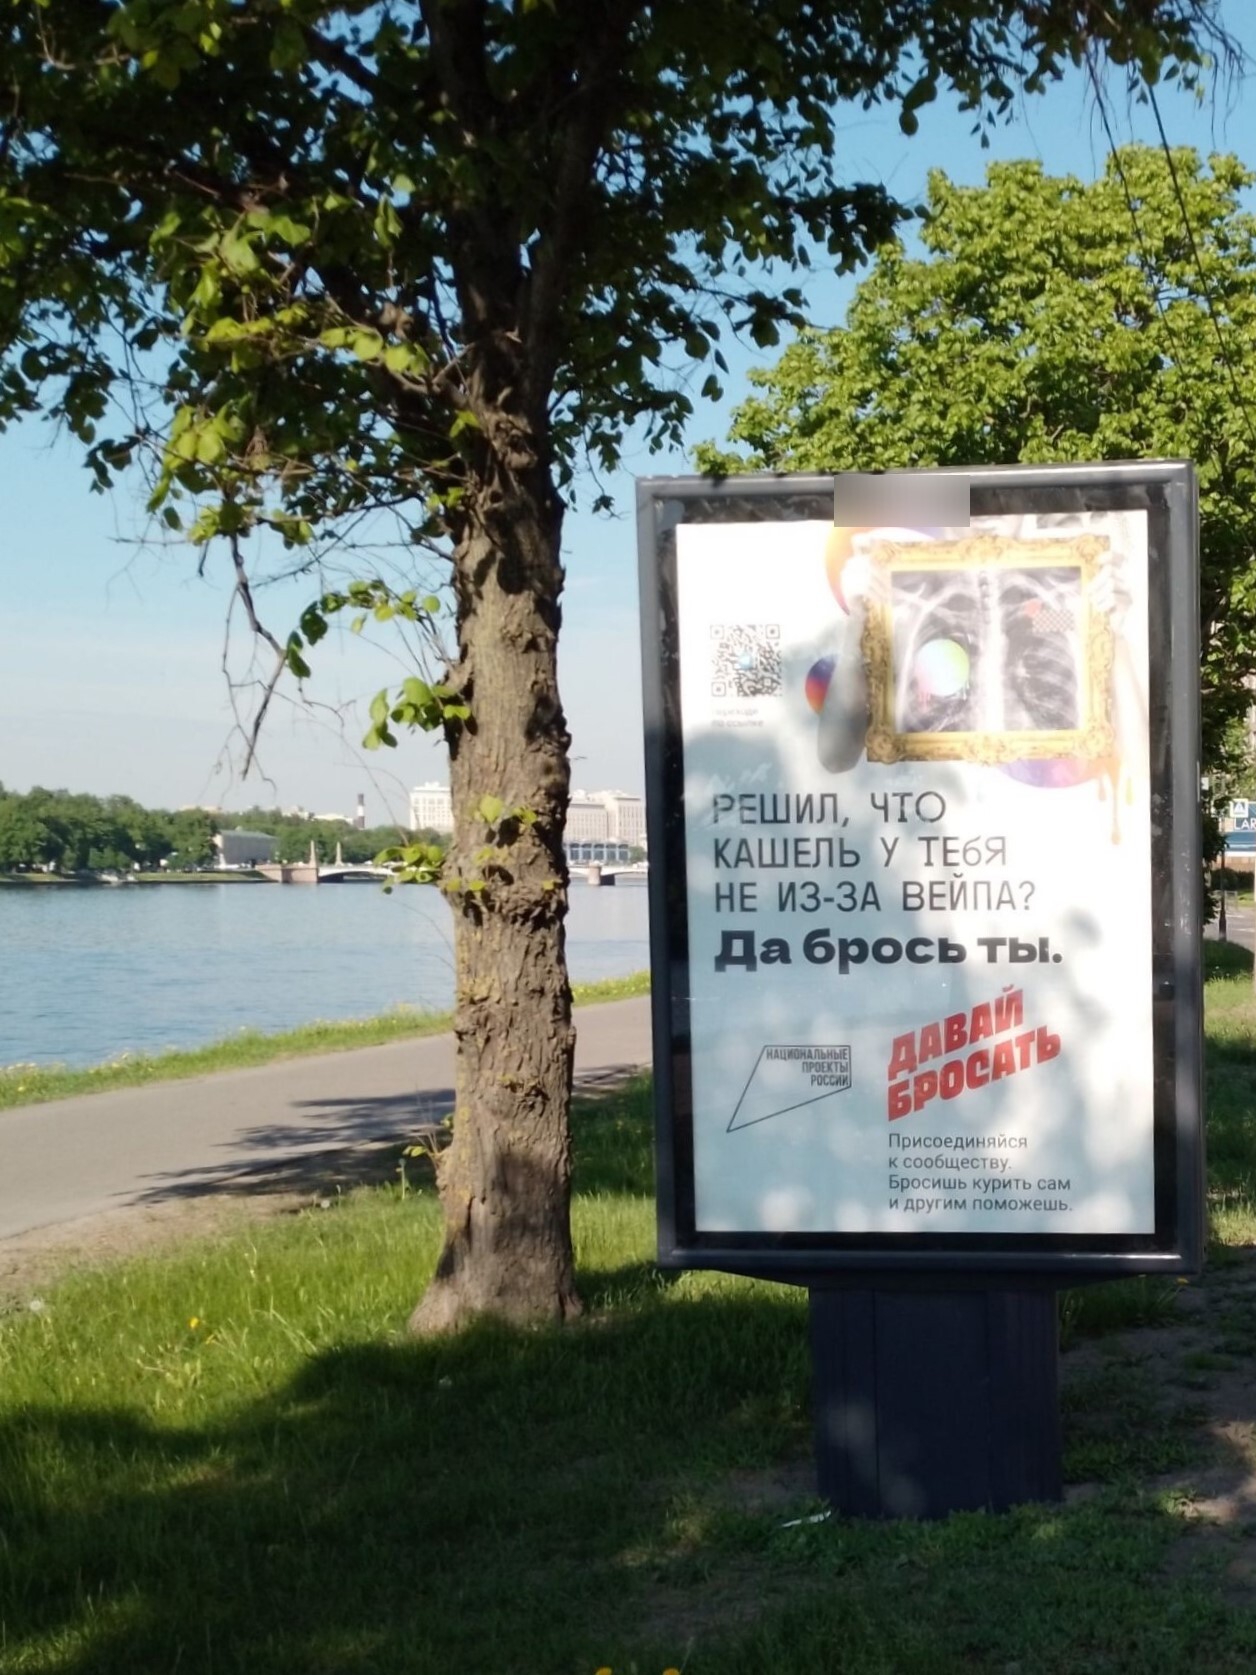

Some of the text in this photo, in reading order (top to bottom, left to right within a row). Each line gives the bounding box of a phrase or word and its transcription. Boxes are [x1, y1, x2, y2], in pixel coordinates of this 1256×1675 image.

[713, 791, 946, 827] РЕШИЛ, ЧТО
[713, 838, 861, 868] КАШЕЛЬ
[880, 837, 899, 867] У
[714, 873, 1036, 912] НЕ ИЗ-ЗА ВЕЙПА?
[714, 928, 1063, 974] Да брось ты.
[888, 984, 1023, 1081] ДАВАЙ
[766, 1048, 848, 1061] НАЦИОНАЛЬНЫЕ
[802, 1061, 848, 1073] ПРОЕКТЫ
[888, 1025, 1061, 1122] БРОСАТЬ
[811, 1074, 849, 1086] РОССИИ
[888, 1133, 1028, 1150] Присоединяйся
[888, 1154, 1012, 1172] к сообществу.
[889, 1174, 1071, 1193] Бросишь курить сам
[889, 1198, 1073, 1214] и другим поможешь.
